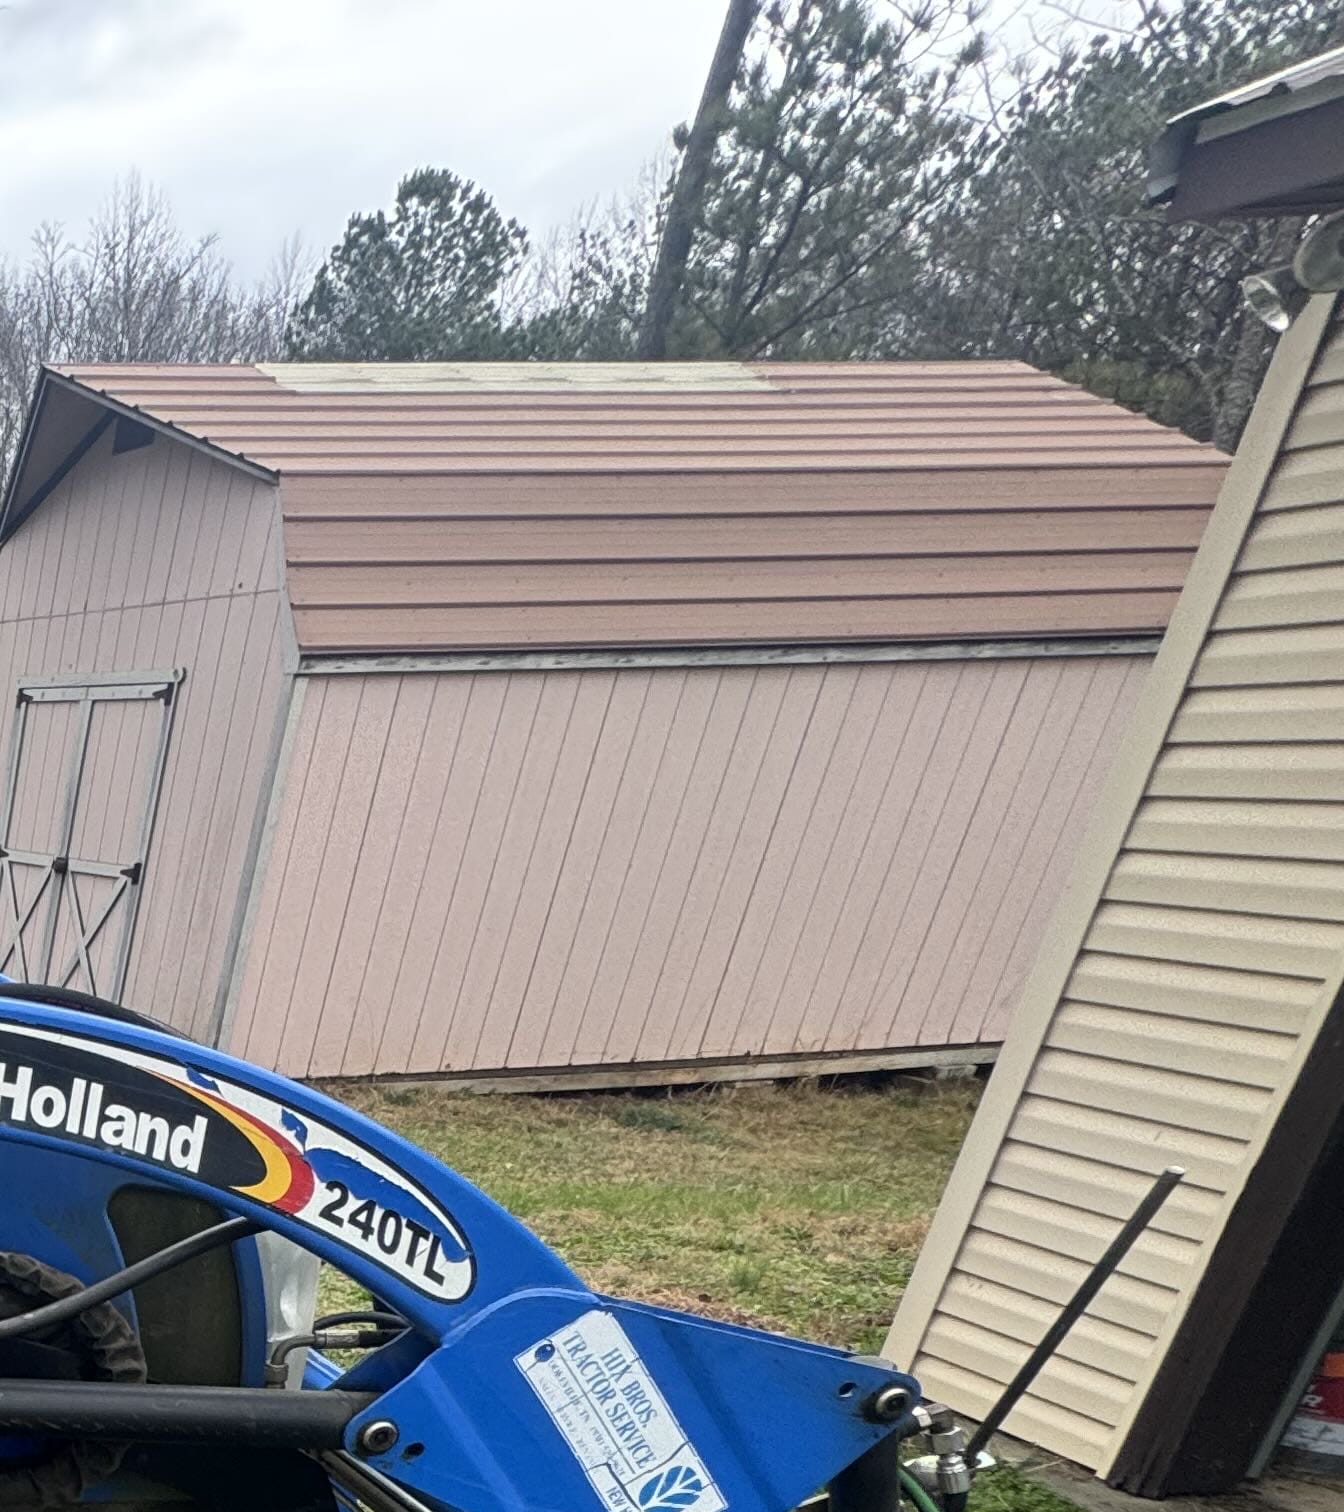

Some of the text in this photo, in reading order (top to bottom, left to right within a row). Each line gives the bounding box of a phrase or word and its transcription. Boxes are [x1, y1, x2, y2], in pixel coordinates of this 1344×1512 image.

[318, 1180, 445, 1287] 240TL
[562, 1331, 616, 1405] TRACTOR
[605, 1402, 657, 1469] SERVICE
[600, 1347, 657, 1428] HIX BROS.
